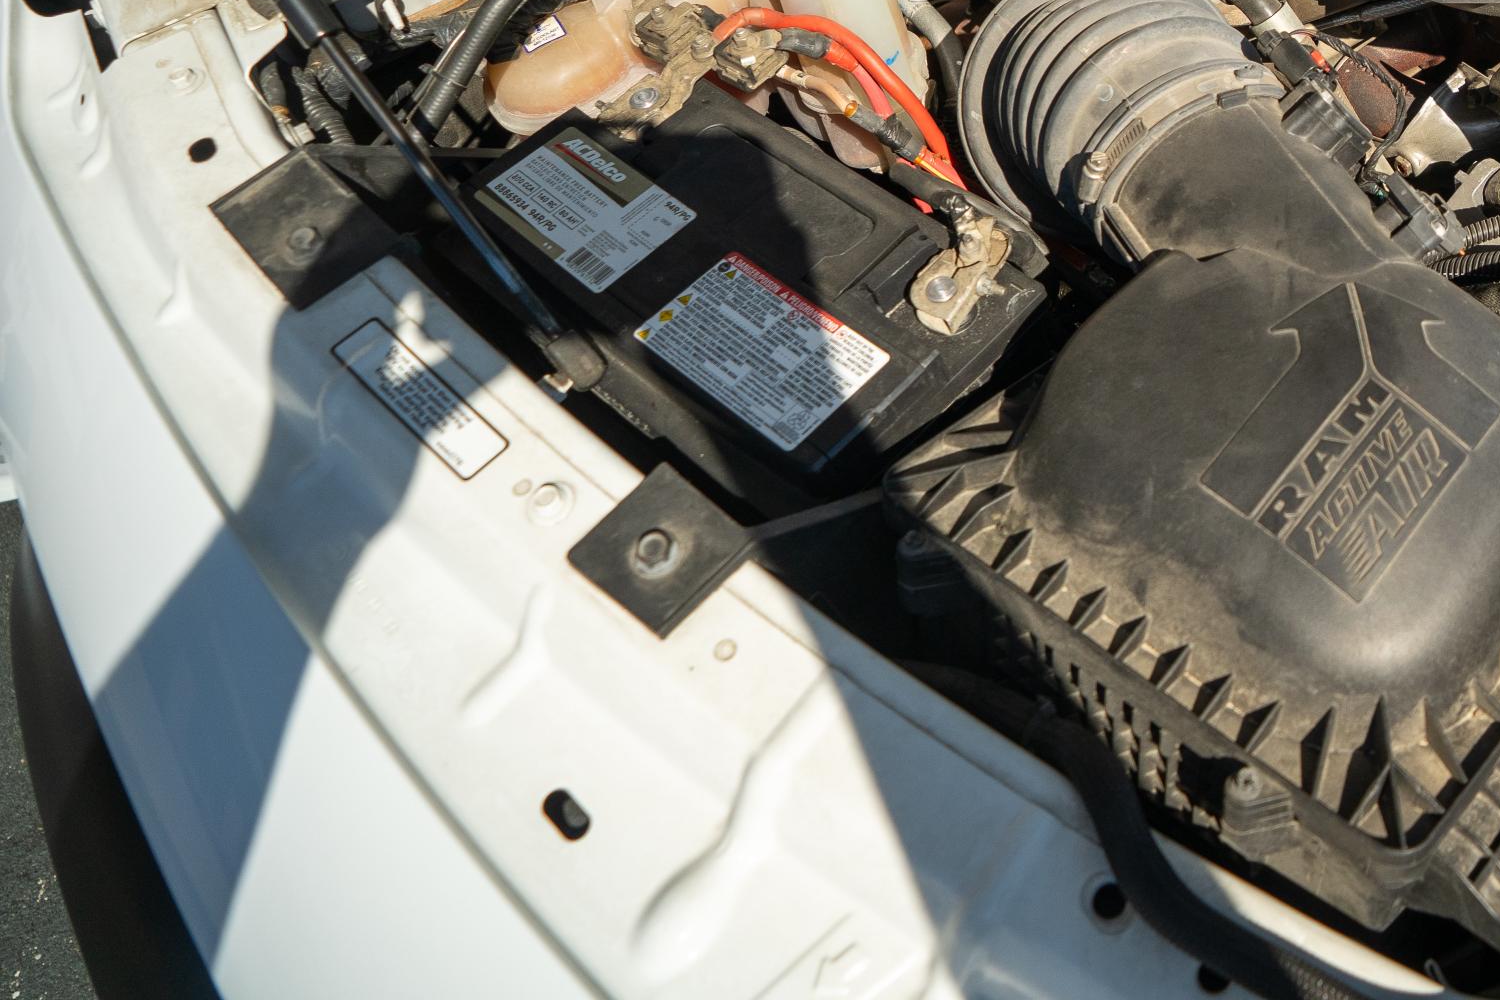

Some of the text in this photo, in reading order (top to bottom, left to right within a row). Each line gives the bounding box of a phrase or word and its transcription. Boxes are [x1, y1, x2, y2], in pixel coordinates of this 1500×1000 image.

[561, 138, 627, 183] ACDelco
[511, 173, 536, 192] 800 CCA
[526, 208, 557, 232] 94R/PG
[545, 199, 558, 208] RC
[662, 201, 691, 221] 94R/PG
[732, 259, 781, 293] DANGER/POISON
[1257, 379, 1392, 537] RAM
[1305, 408, 1414, 561] ACTIVE
[1340, 428, 1449, 572] AIR
